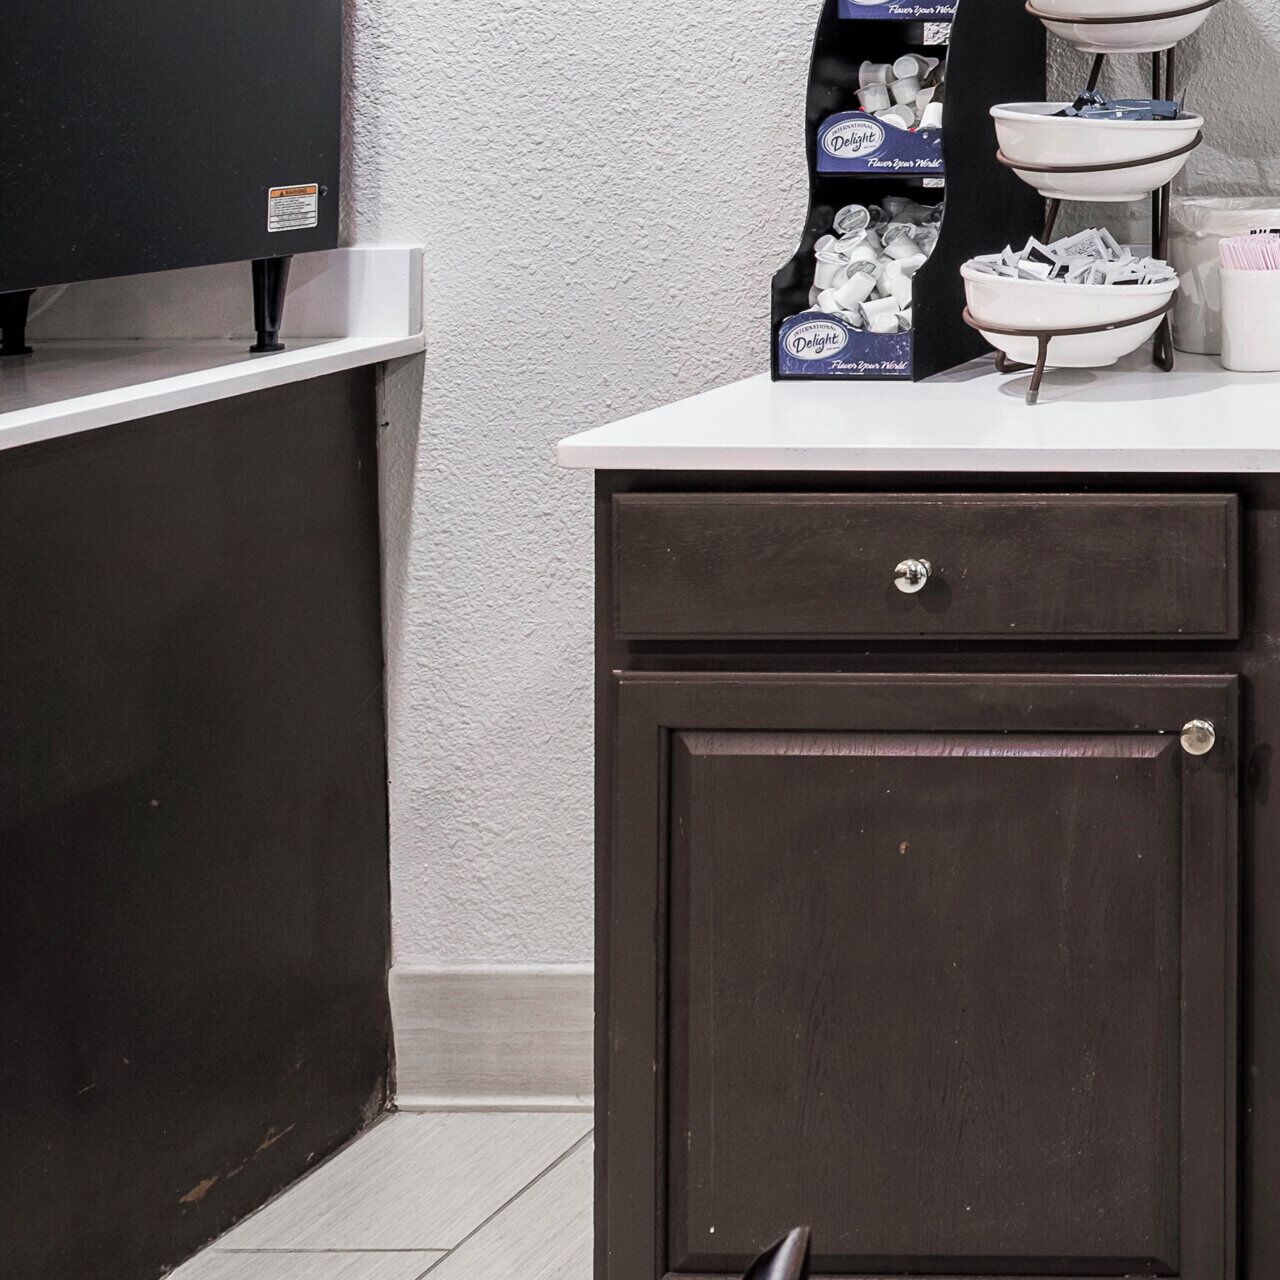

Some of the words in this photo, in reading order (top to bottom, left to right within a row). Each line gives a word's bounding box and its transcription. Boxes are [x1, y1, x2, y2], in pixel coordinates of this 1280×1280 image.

[915, 5, 935, 16] Your
[831, 132, 876, 152] Delight
[893, 158, 914, 170] Your
[915, 158, 943, 168] World
[793, 333, 839, 353] Delight
[858, 360, 880, 372] Your
[881, 361, 908, 369] World
